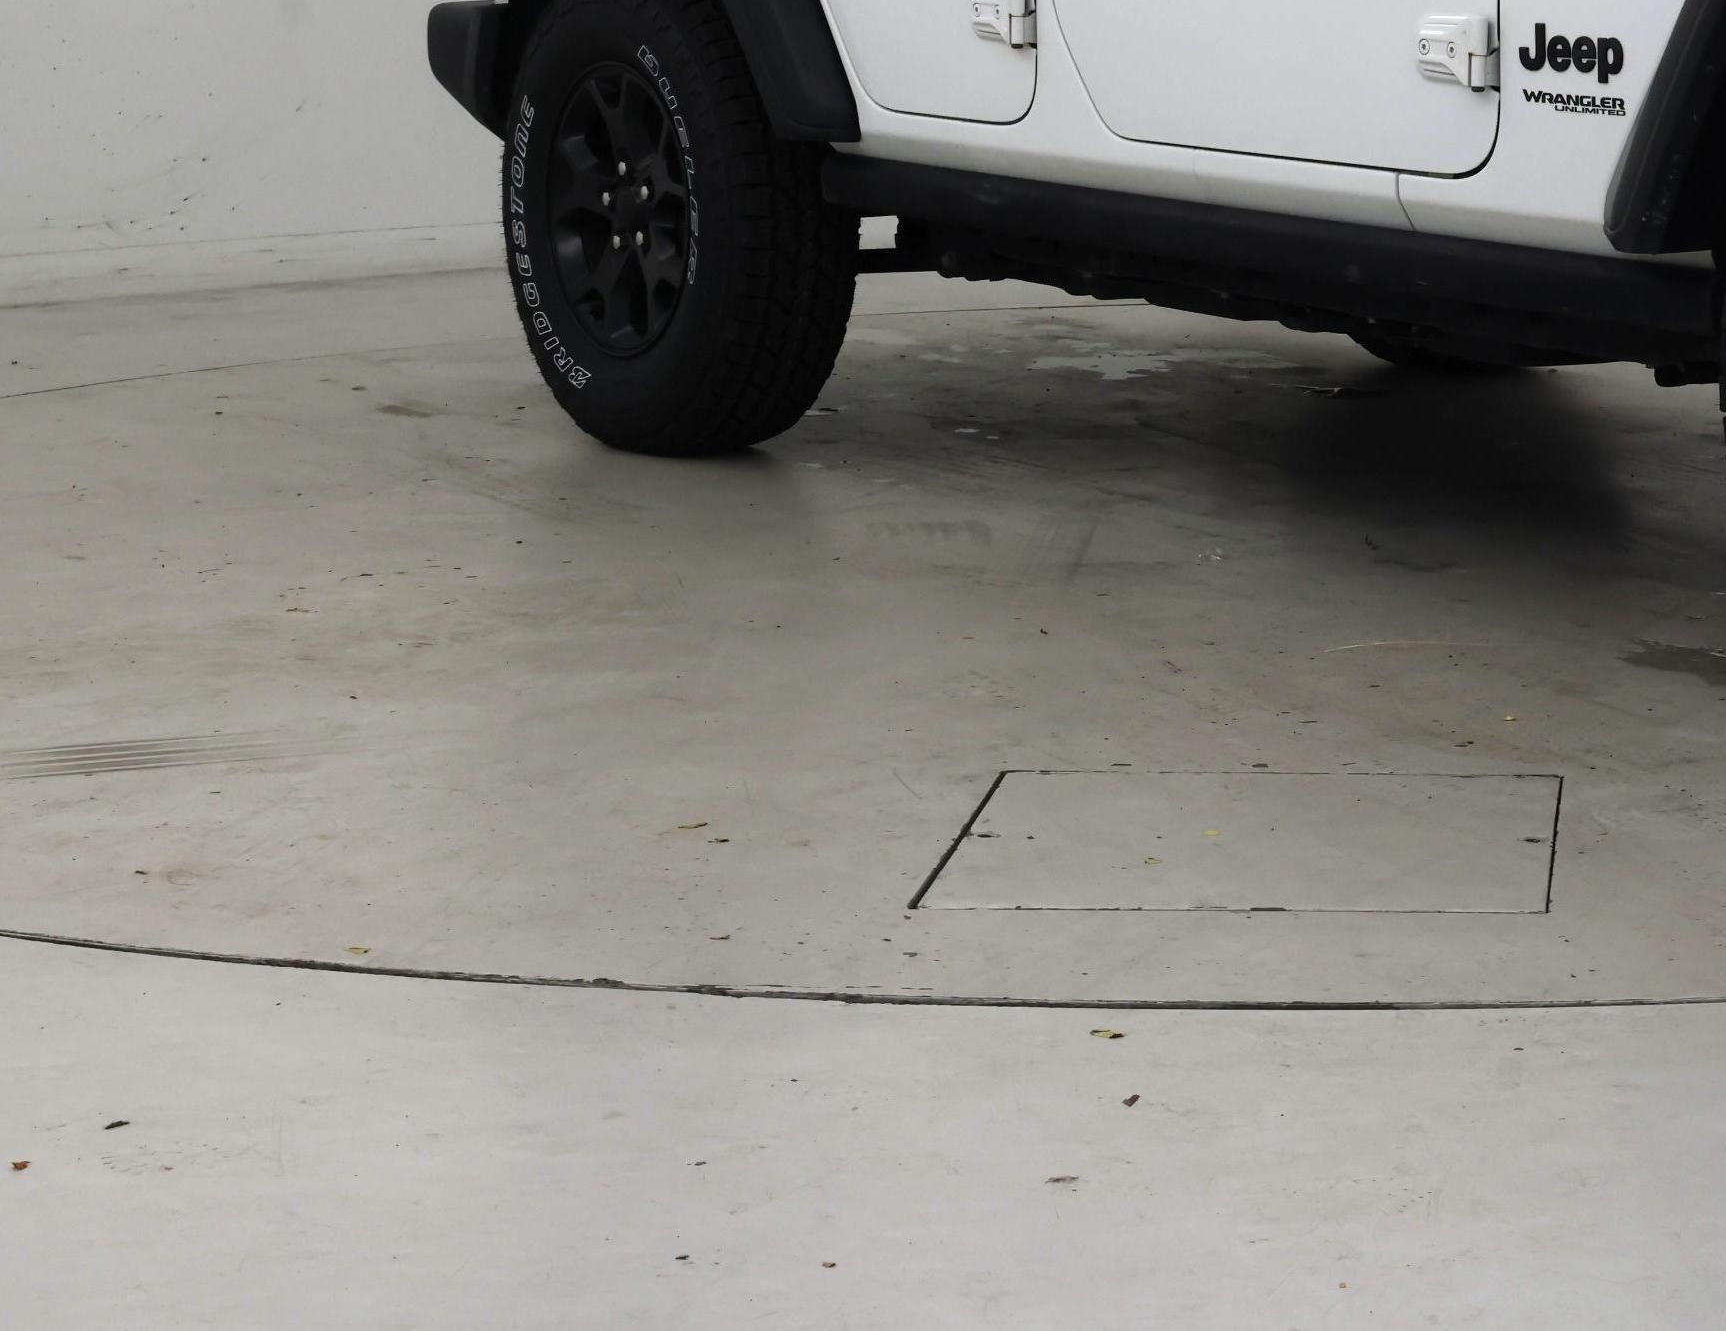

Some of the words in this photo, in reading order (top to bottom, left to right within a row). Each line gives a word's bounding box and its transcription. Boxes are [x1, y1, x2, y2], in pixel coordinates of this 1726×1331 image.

[1519, 23, 1624, 83] Jeep
[1522, 88, 1626, 110] WRANGLER
[1554, 104, 1626, 117] UNLIMITED
[510, 95, 592, 389] BRIDGESTONE
